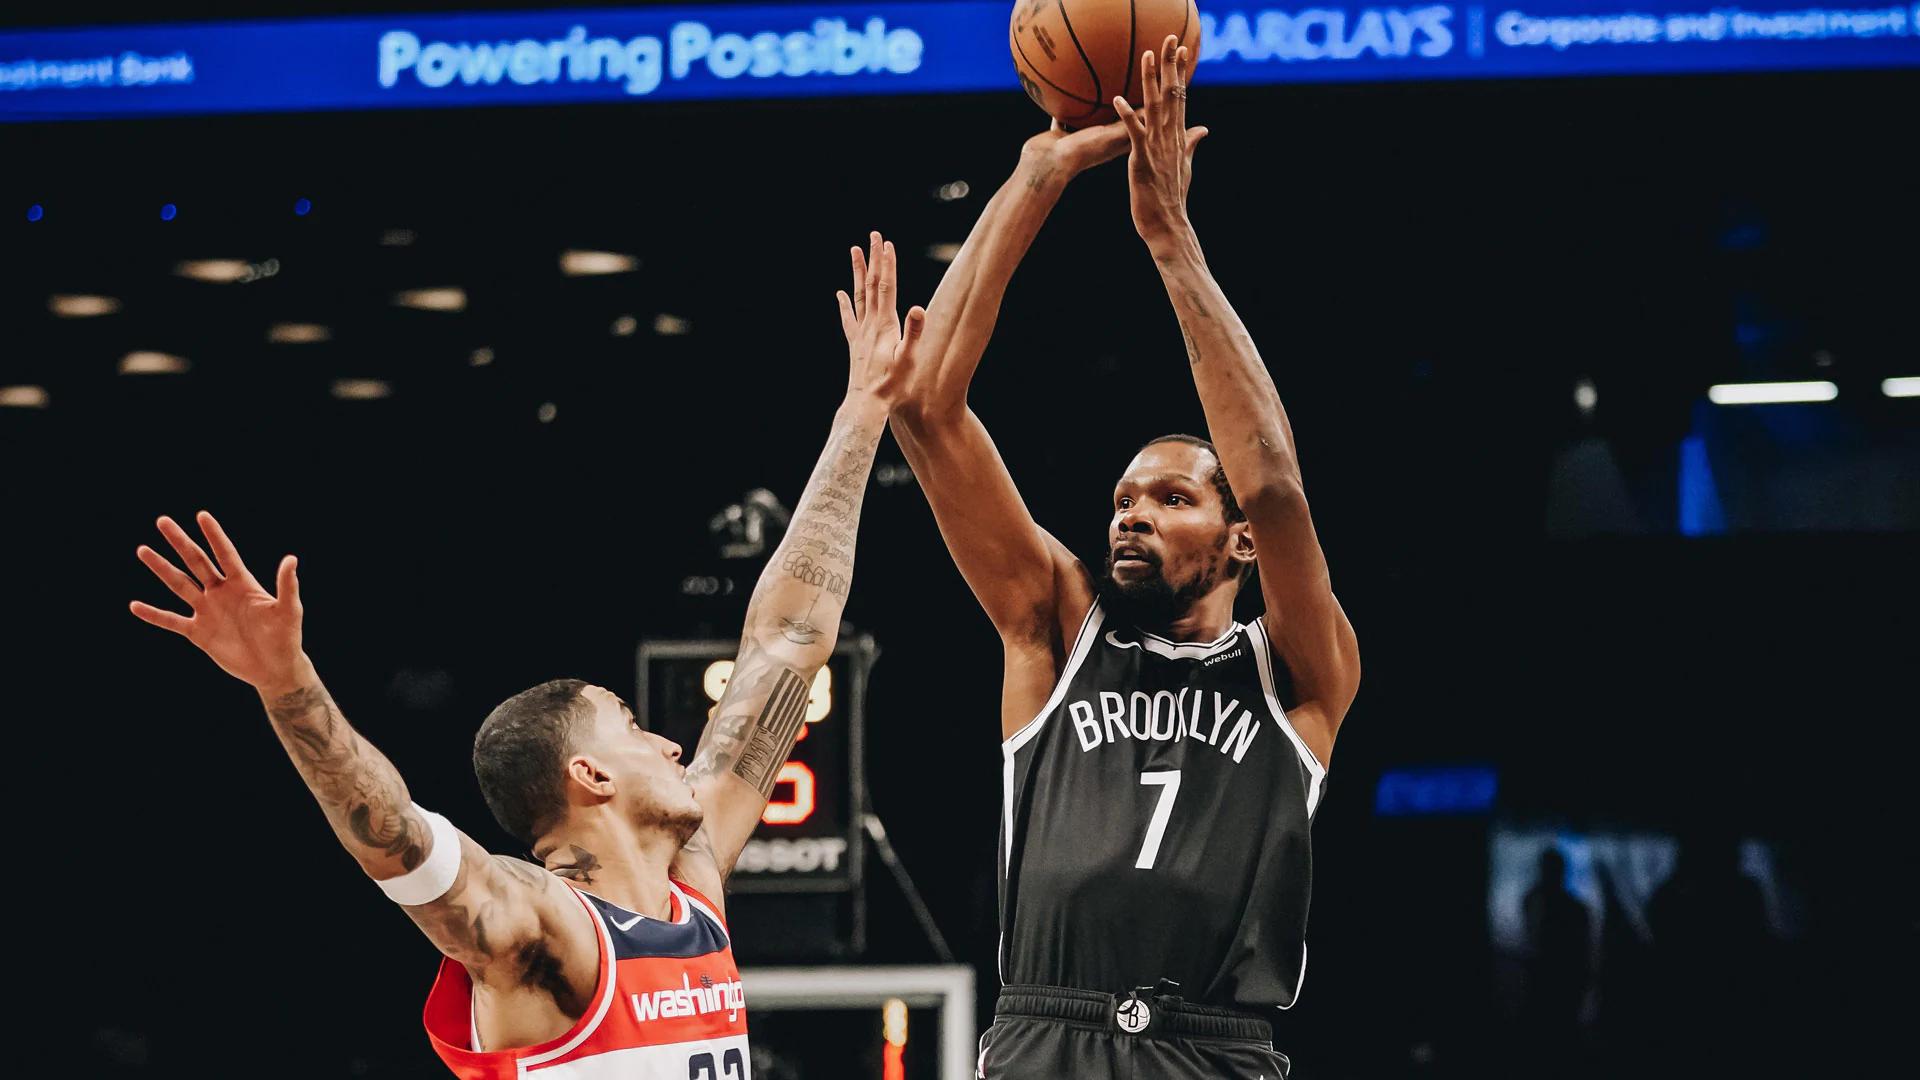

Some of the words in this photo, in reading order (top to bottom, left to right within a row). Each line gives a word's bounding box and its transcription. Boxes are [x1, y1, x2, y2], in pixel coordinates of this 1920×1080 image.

[378, 25, 662, 95] Powering
[670, 16, 924, 79] Possible
[1495, 10, 1664, 51] Corporate
[1666, 9, 1727, 42] and
[1731, 6, 1908, 40] Investment
[1204, 649, 1241, 667] webull
[1135, 769, 1181, 869] 7
